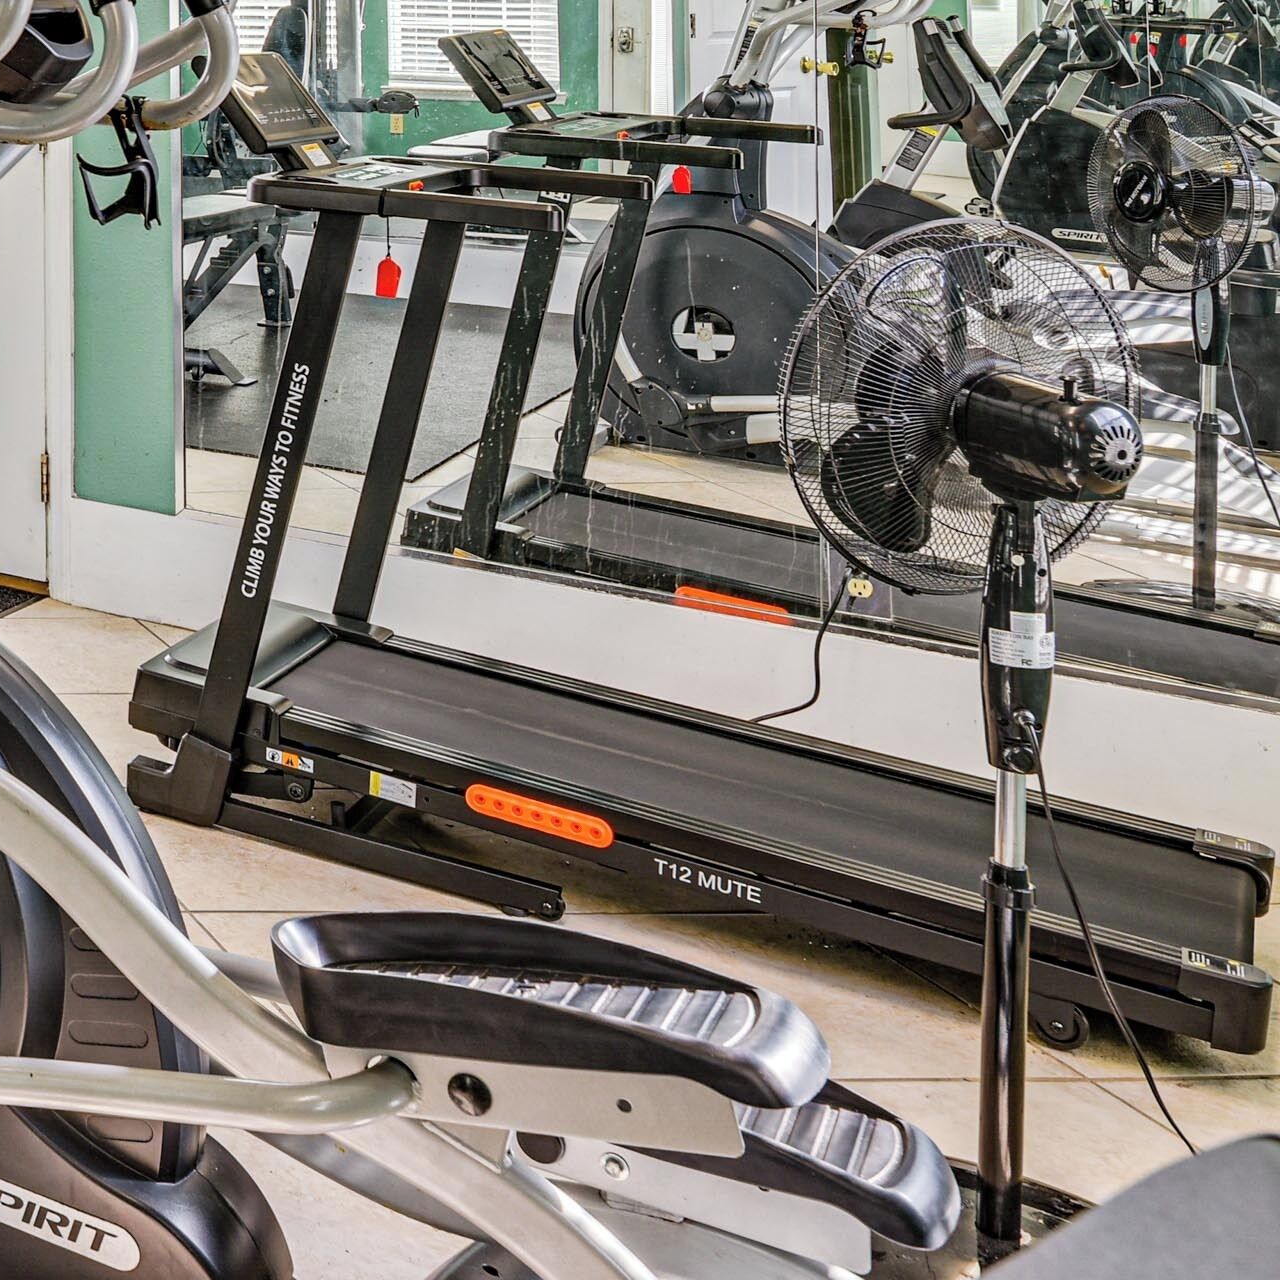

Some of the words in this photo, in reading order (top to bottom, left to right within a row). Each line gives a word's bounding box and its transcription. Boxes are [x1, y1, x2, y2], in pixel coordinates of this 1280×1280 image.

[281, 362, 310, 430] FITNESS
[274, 429, 294, 453] TO
[263, 454, 288, 501] WAYS
[253, 501, 277, 546] YOUR
[241, 546, 266, 599] CLIMB
[654, 858, 692, 884] T12
[698, 871, 762, 904] MUTE
